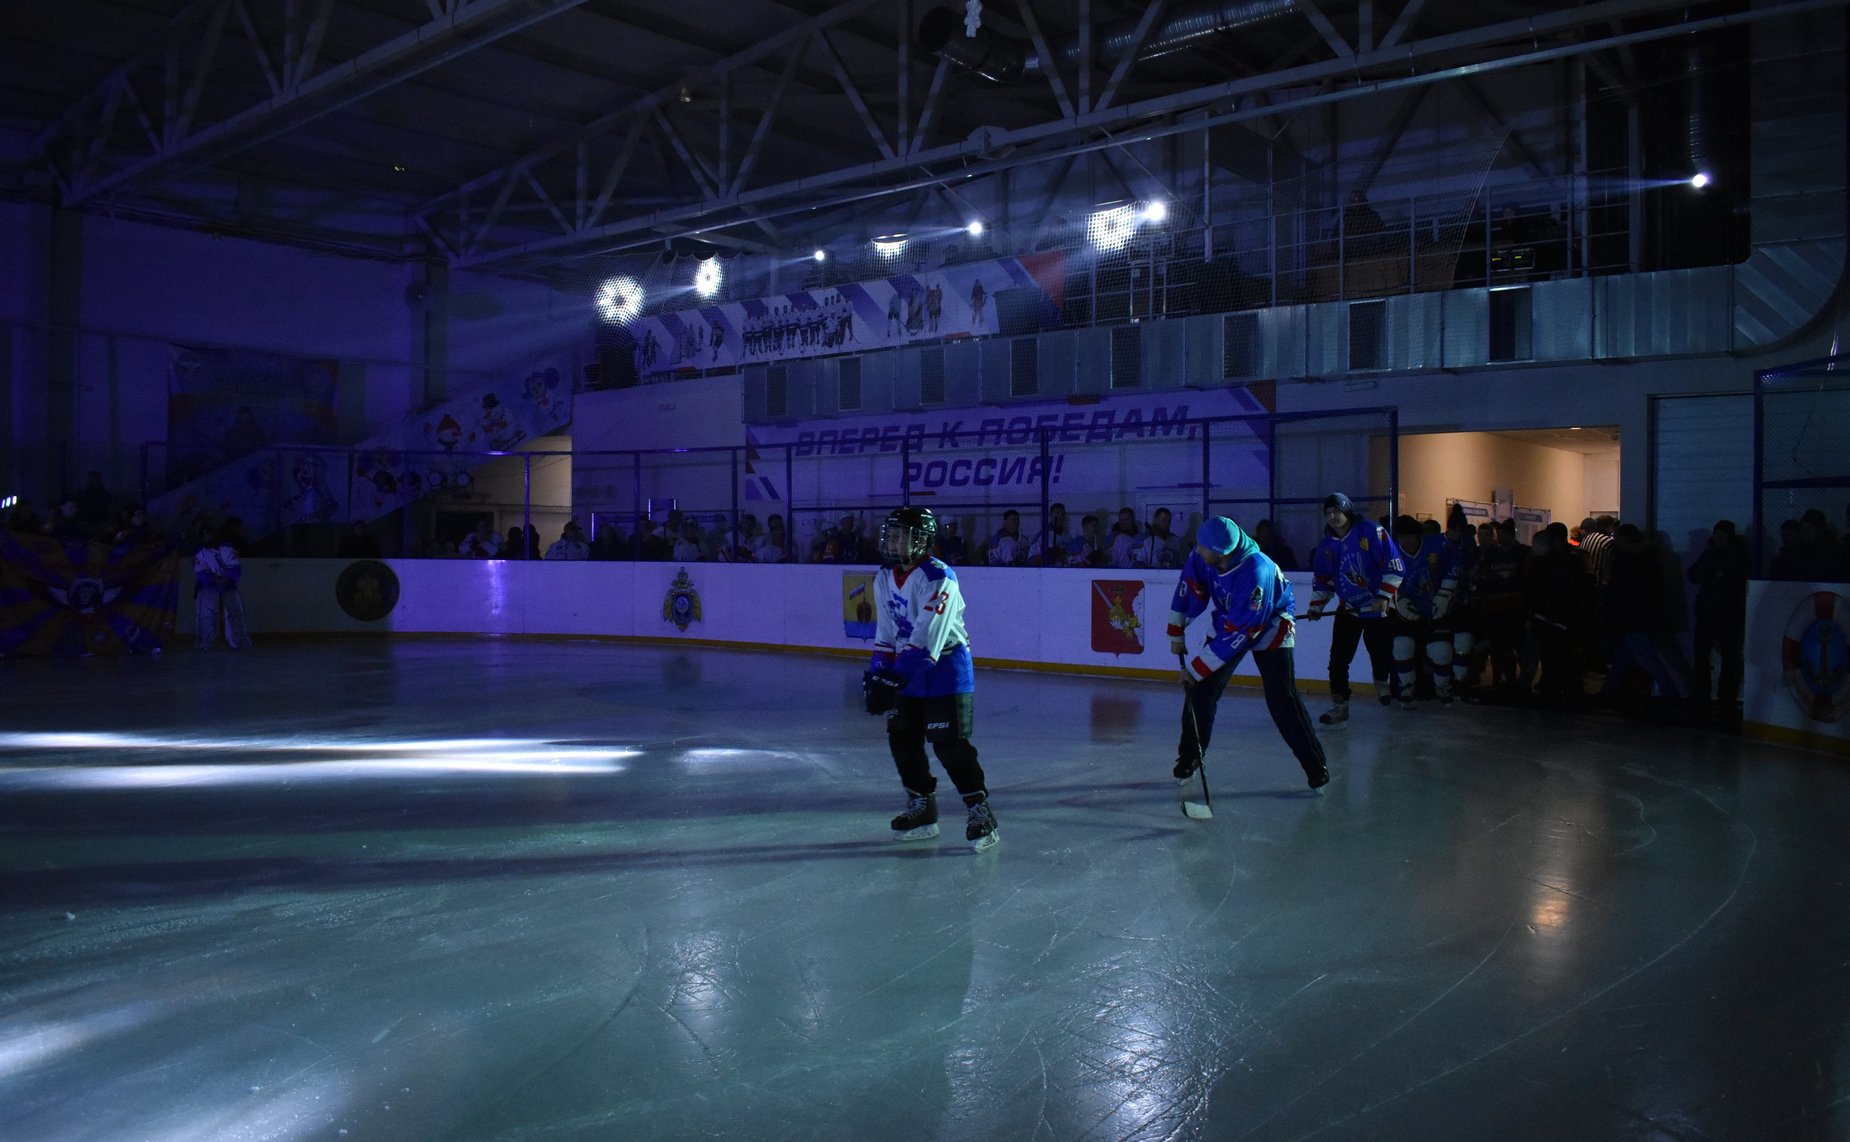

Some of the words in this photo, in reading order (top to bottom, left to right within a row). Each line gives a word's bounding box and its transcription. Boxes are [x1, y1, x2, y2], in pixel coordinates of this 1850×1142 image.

[939, 421, 964, 448] К
[978, 405, 1197, 446] ПОБЕДАМ,
[900, 455, 1064, 488] РОССИЯ!
